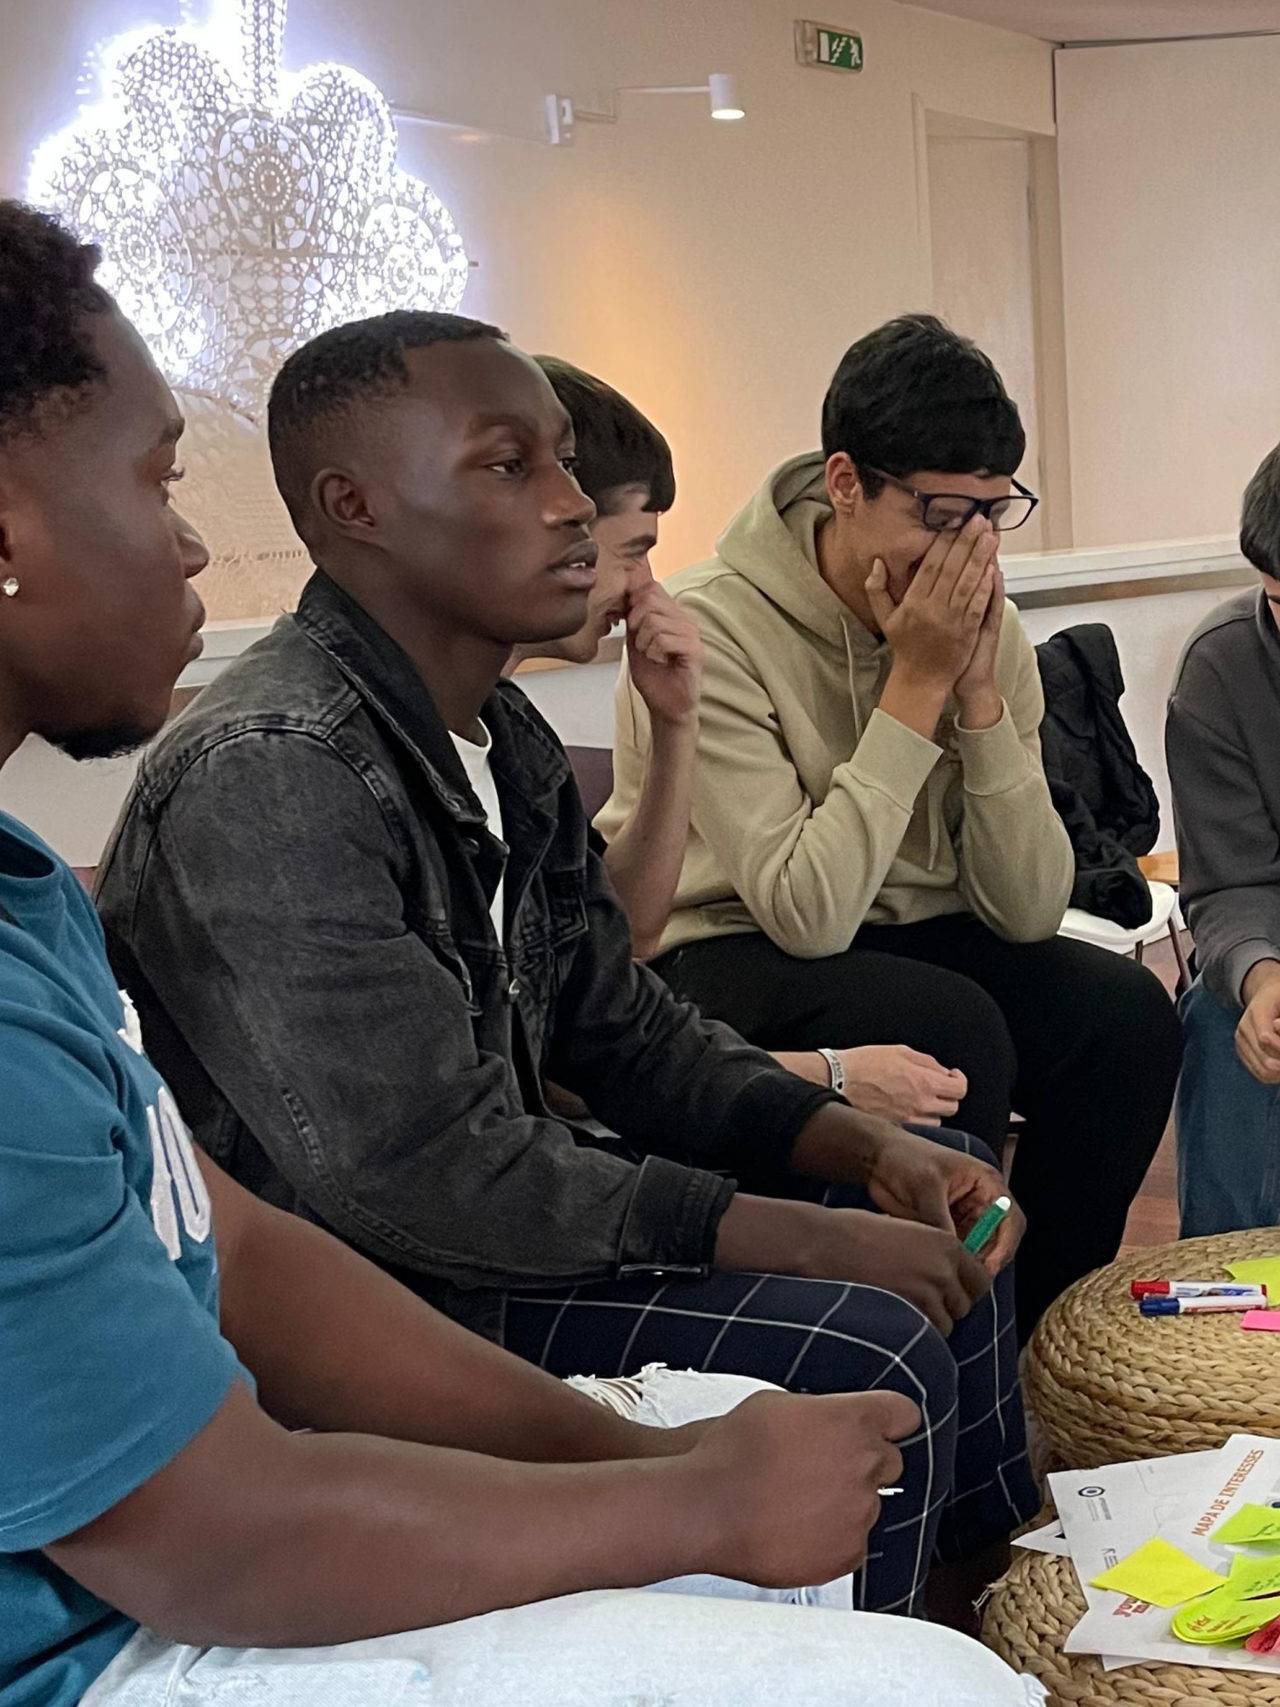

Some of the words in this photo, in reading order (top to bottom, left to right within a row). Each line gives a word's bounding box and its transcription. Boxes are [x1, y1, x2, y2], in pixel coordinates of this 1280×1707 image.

[1218, 1449, 1264, 1498] INTERESSES
[1210, 1499, 1230, 1512] DE
[1191, 1511, 1222, 1536] MAPA
